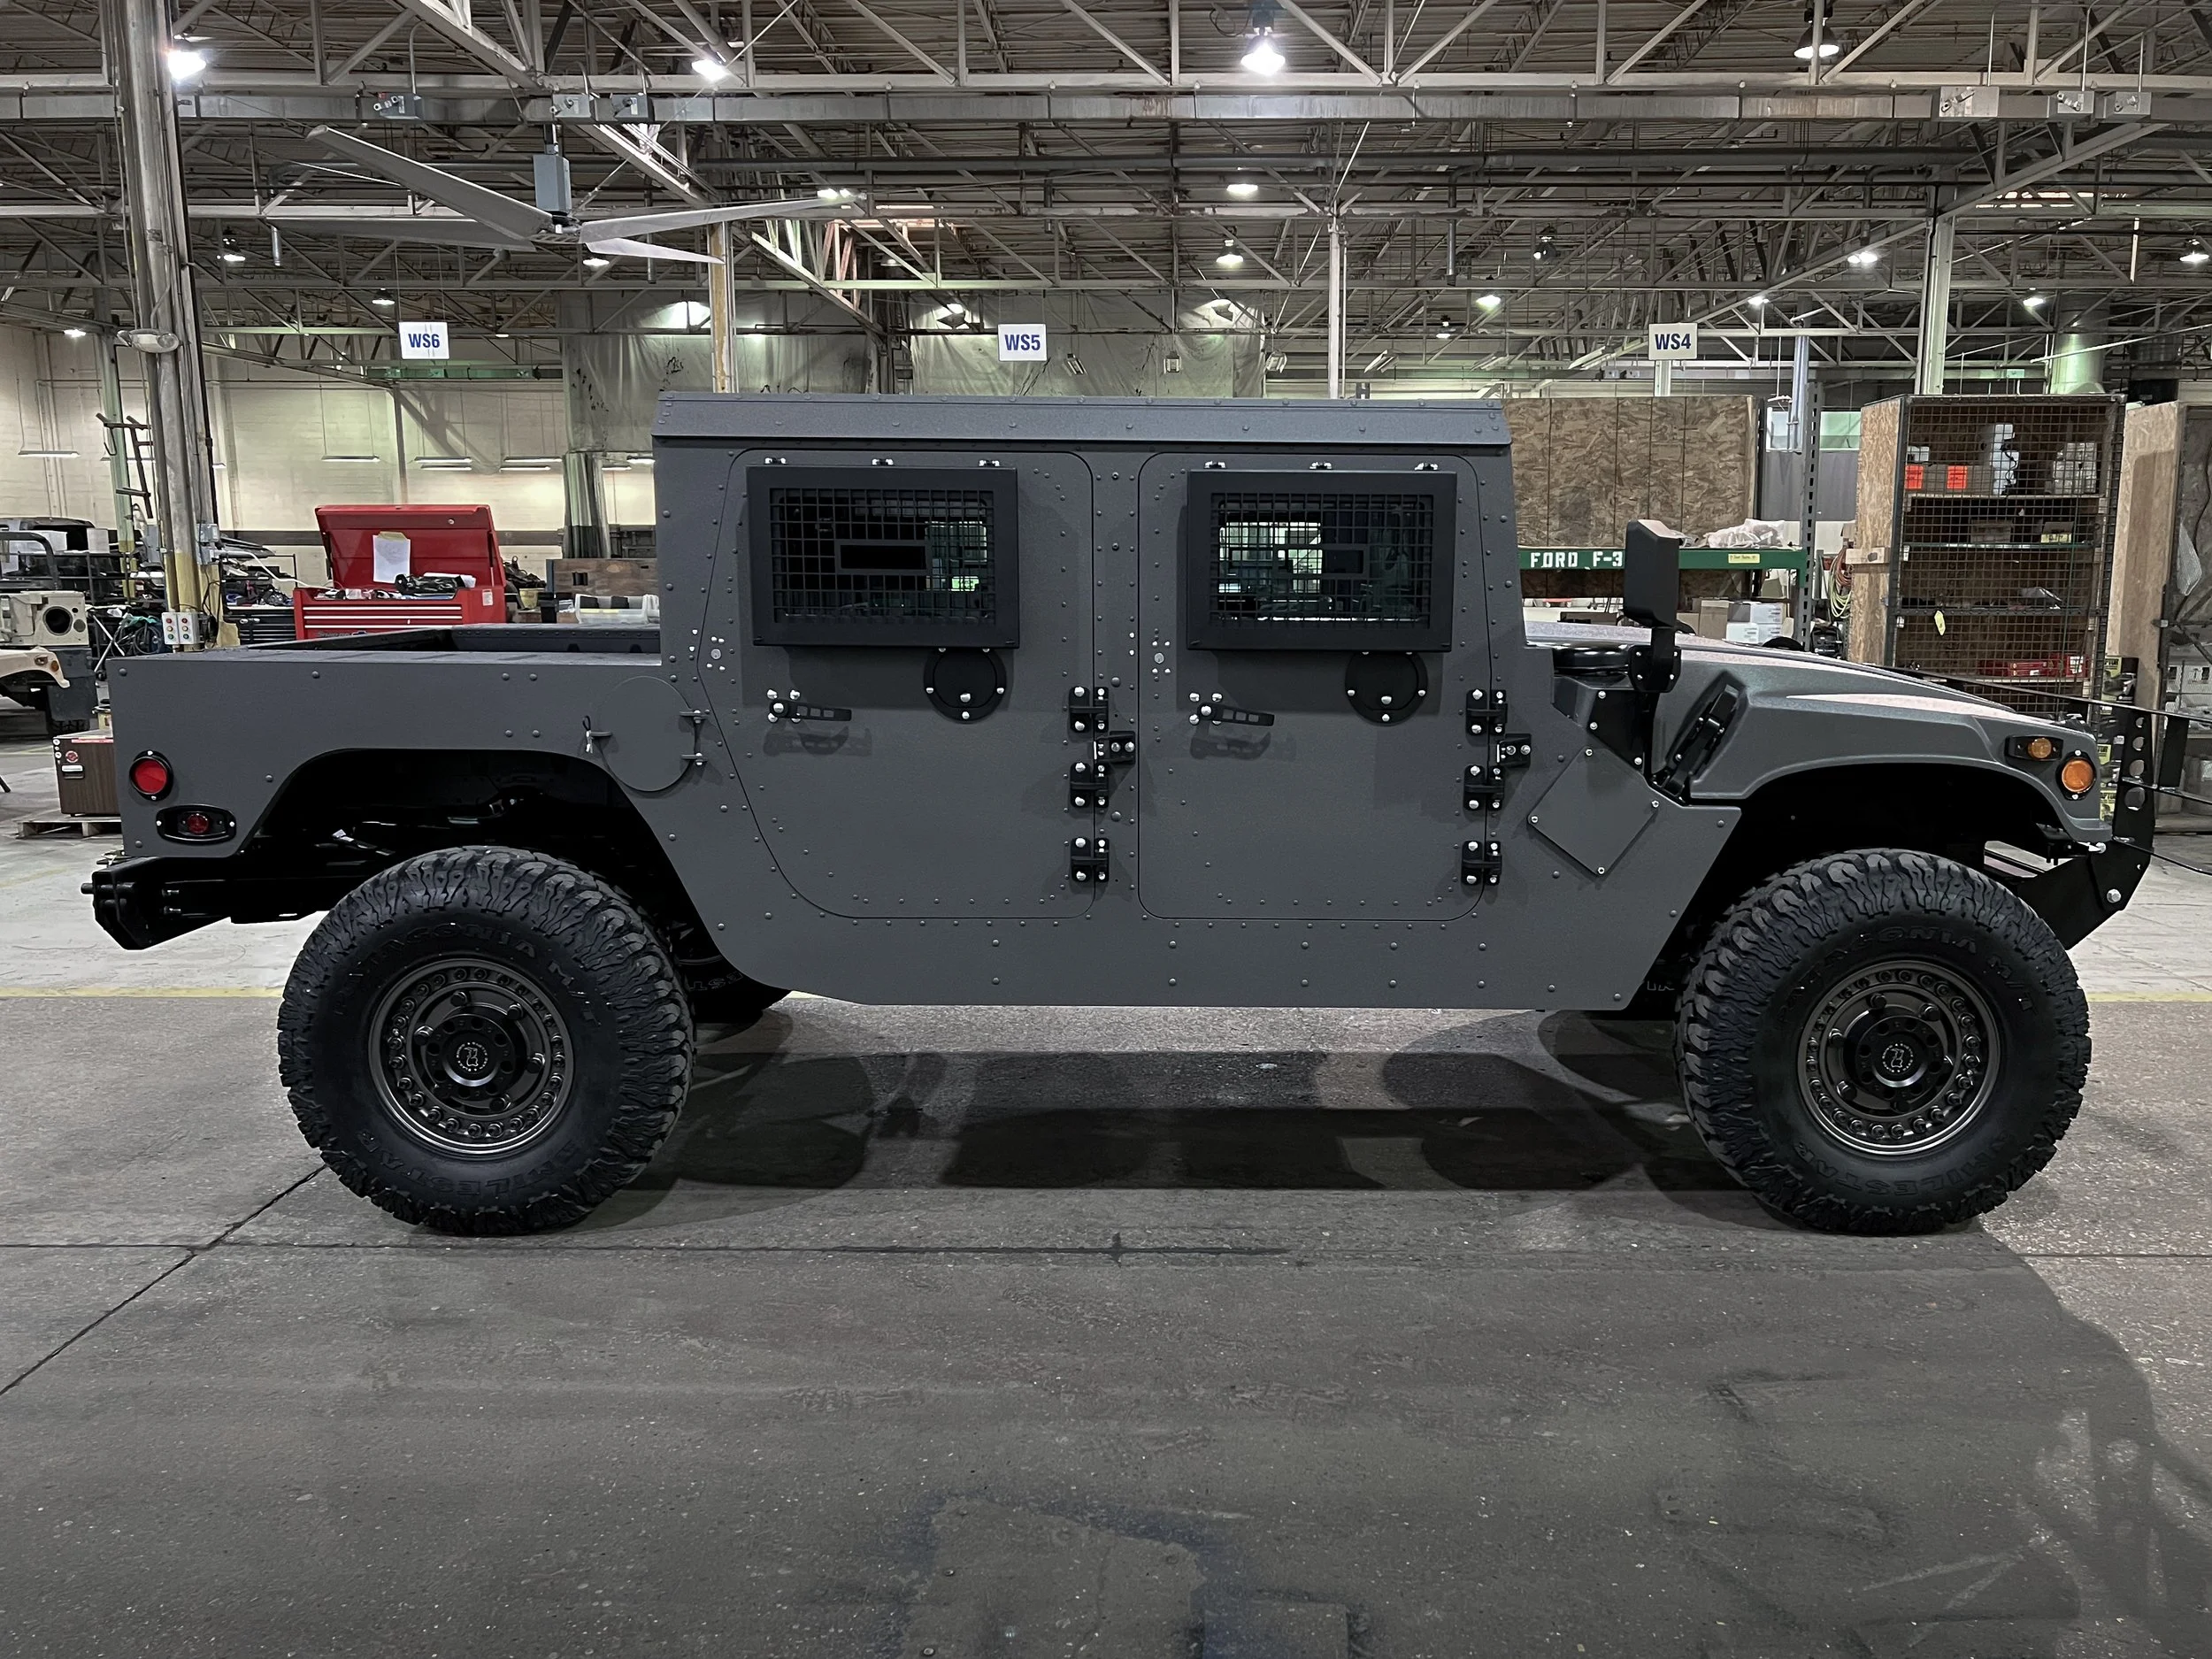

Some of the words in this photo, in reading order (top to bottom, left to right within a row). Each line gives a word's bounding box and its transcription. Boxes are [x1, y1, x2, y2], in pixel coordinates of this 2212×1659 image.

[408, 334, 441, 349] WS6
[1004, 334, 1041, 350] WS5
[1655, 334, 1692, 350] WS4
[1530, 551, 1578, 568] FORD
